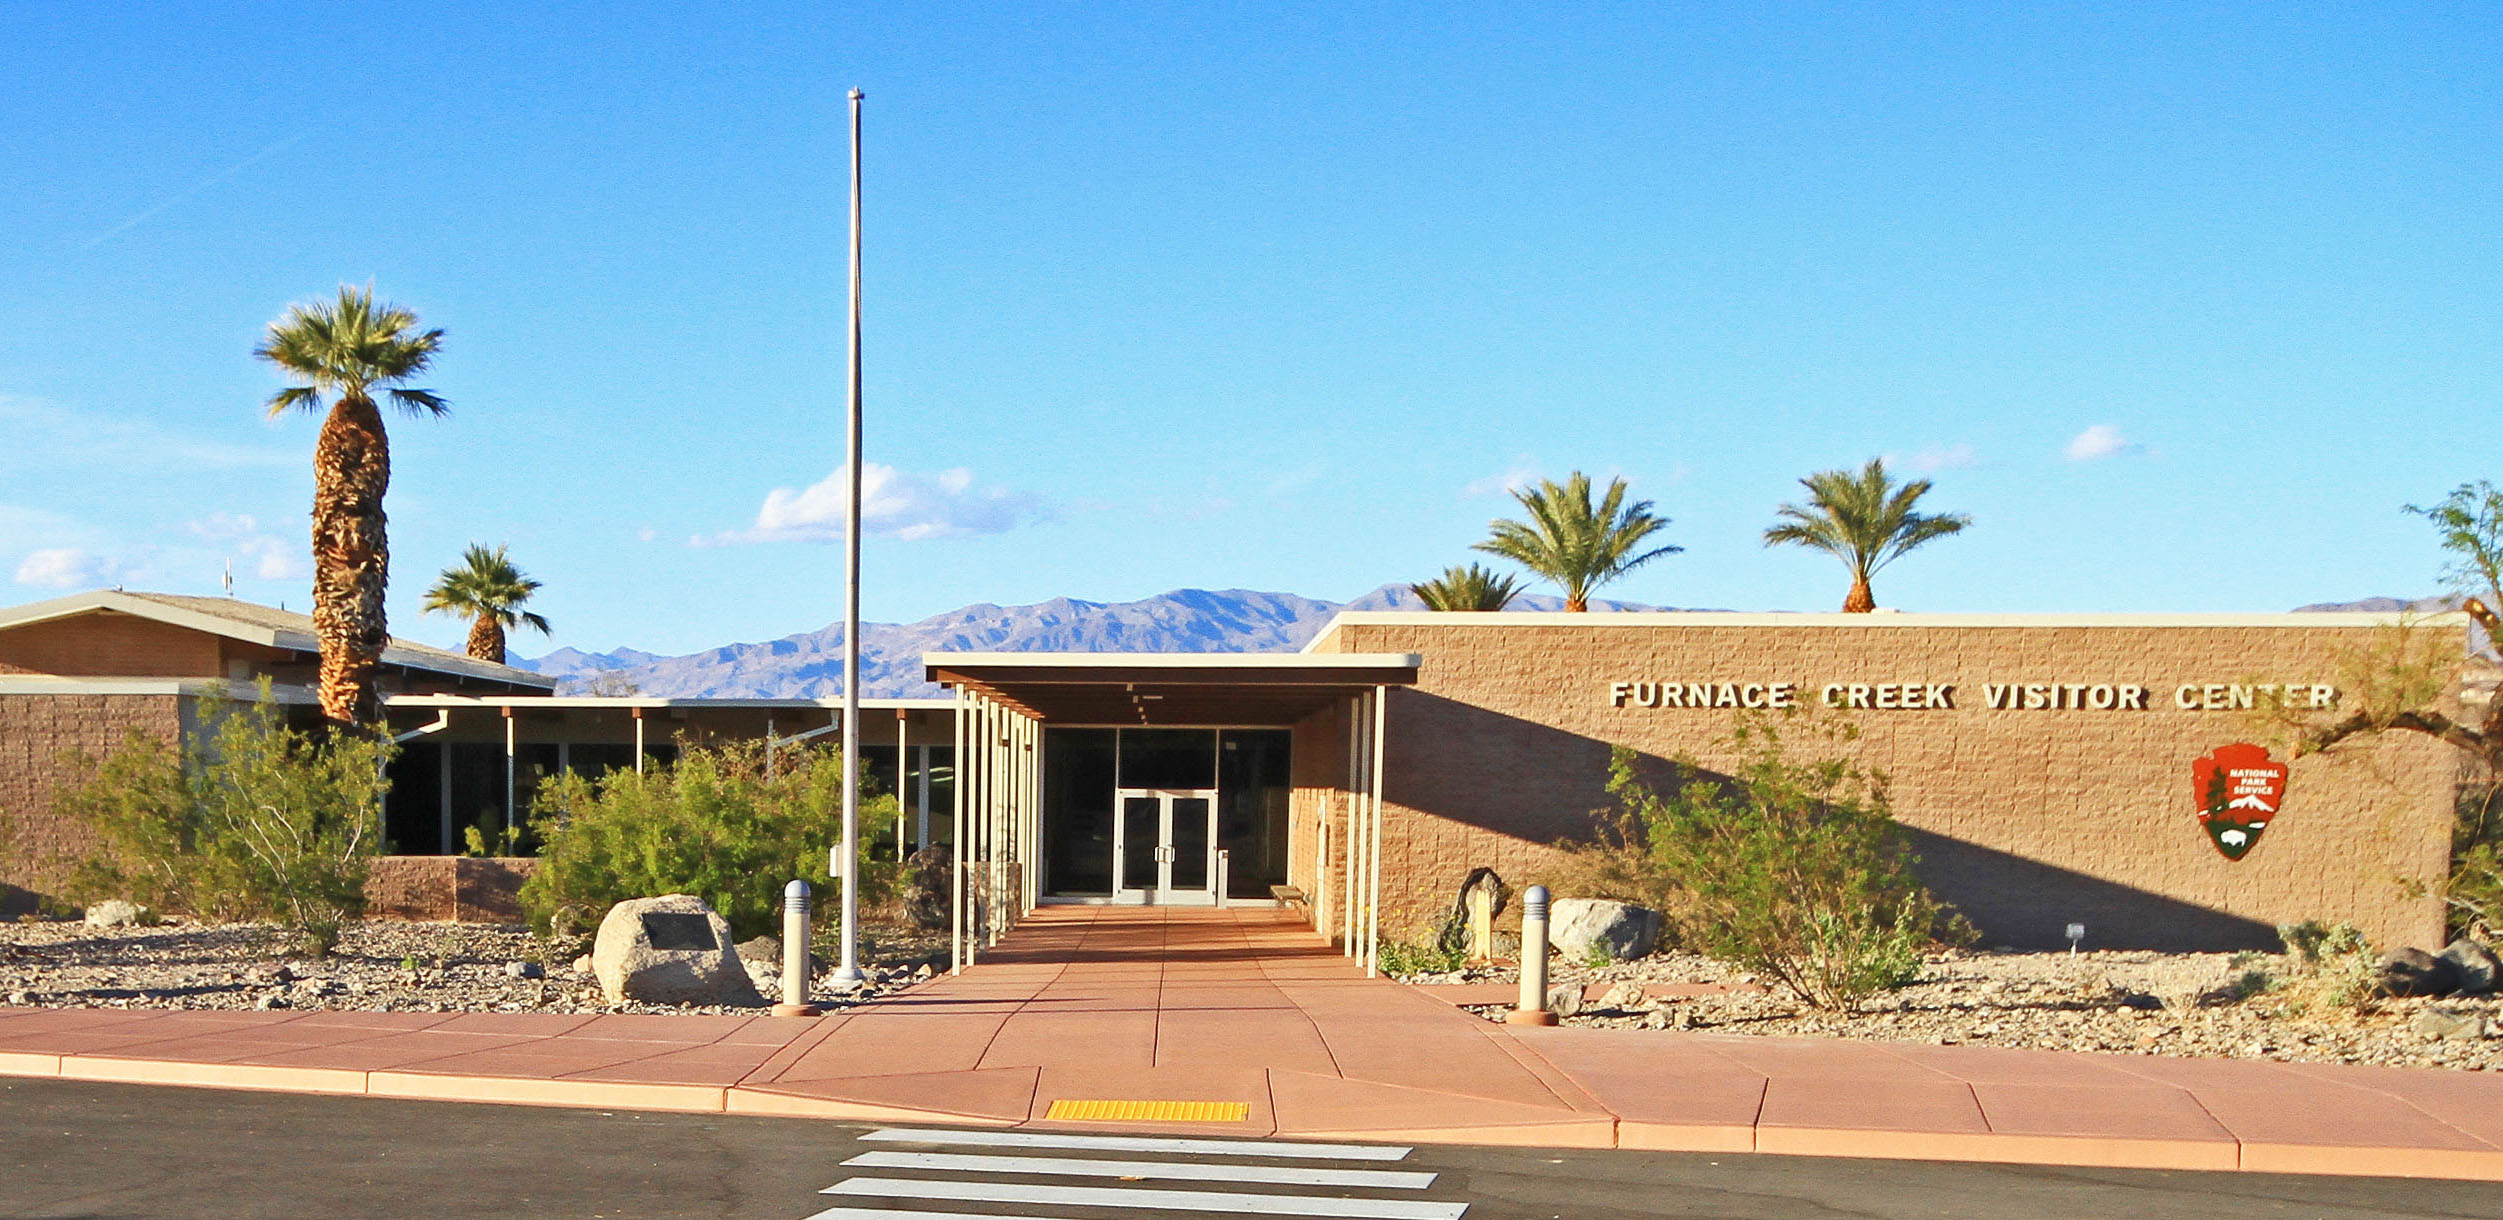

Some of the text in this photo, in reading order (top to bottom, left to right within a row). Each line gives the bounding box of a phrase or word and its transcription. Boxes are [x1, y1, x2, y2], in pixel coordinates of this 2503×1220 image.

[1609, 682, 1790, 708] FURNACE
[1821, 683, 1950, 708] CREEK
[1981, 683, 2142, 709] VISITOR
[2229, 768, 2280, 778] NATIONAL
[2240, 777, 2268, 786] PARK
[2233, 785, 2274, 795] SERVICE
